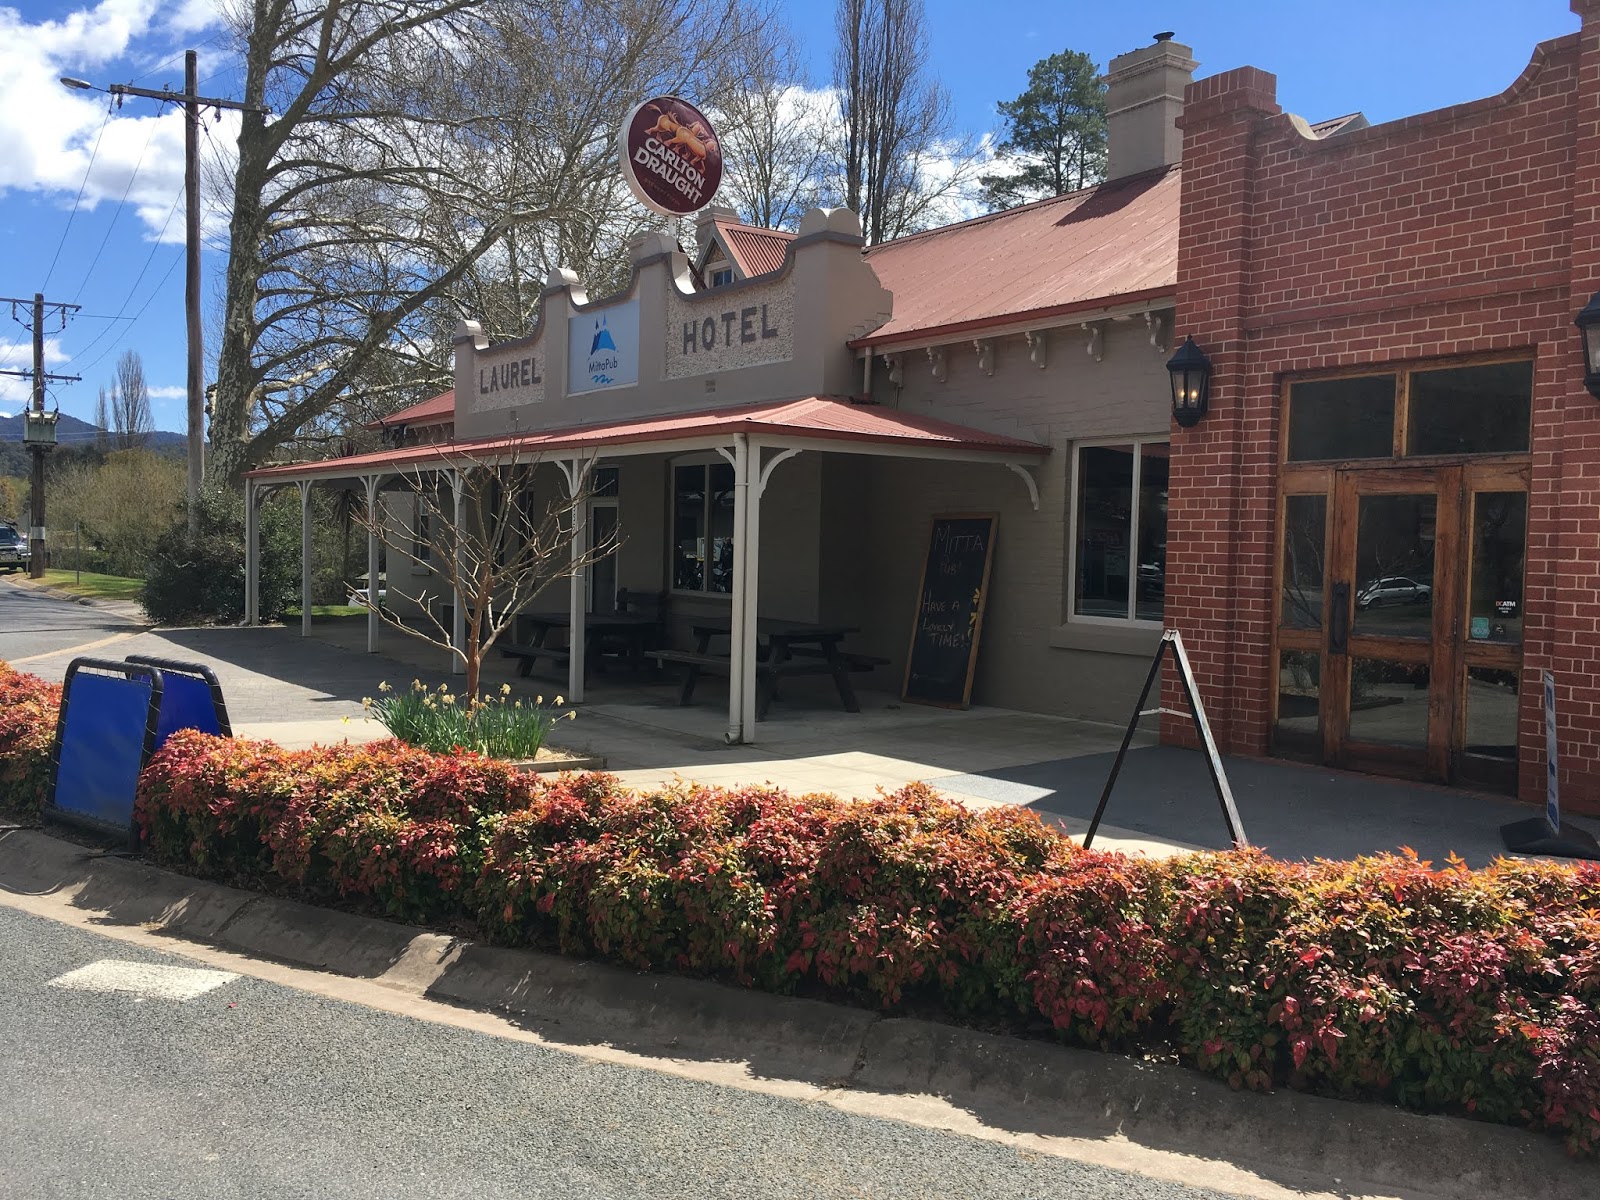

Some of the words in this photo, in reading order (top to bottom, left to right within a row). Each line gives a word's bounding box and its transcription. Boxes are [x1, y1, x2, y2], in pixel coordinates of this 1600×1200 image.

[633, 147, 703, 205] DRAUGHT
[644, 137, 706, 190] CARLTON
[683, 304, 778, 355] HOTEL
[479, 357, 542, 394] LAUREL
